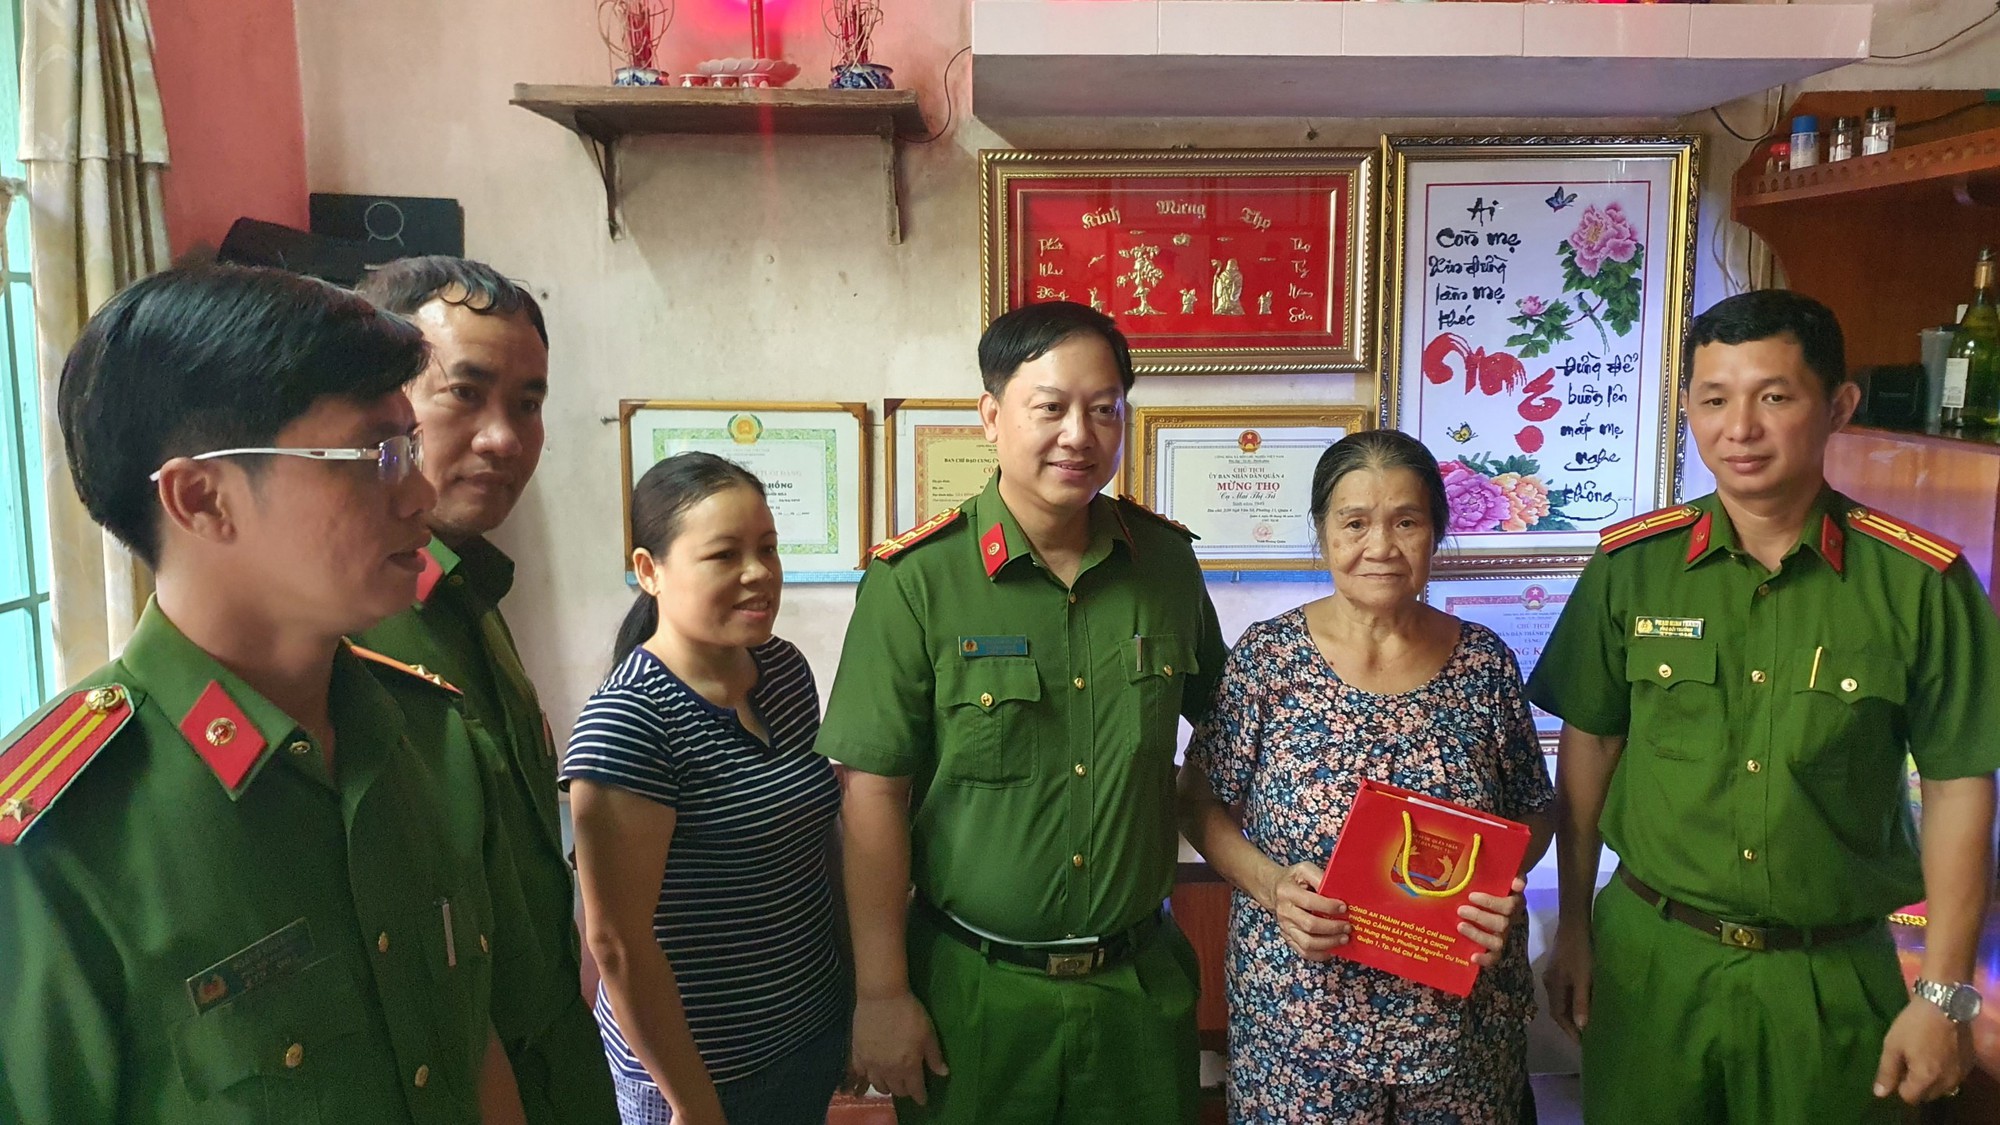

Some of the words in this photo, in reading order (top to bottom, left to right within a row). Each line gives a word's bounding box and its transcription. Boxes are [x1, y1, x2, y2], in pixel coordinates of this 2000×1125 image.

[1082, 207, 1121, 230] Kính
[1242, 206, 1272, 233] Thọ
[1466, 197, 1500, 227] Ai
[1217, 480, 1252, 491] MỪNG
[1255, 482, 1280, 492] THỌ
[1348, 904, 1368, 915] CÔNG
[1368, 911, 1378, 919] AN
[1379, 912, 1400, 926] THÀNH
[1439, 933, 1456, 944] MINH
[1356, 934, 1374, 945] Quận
[1413, 953, 1429, 963] Minh
[1404, 931, 1423, 942] PCCC
[1429, 940, 1449, 951] CNCH
[1455, 957, 1470, 967] Trinh
